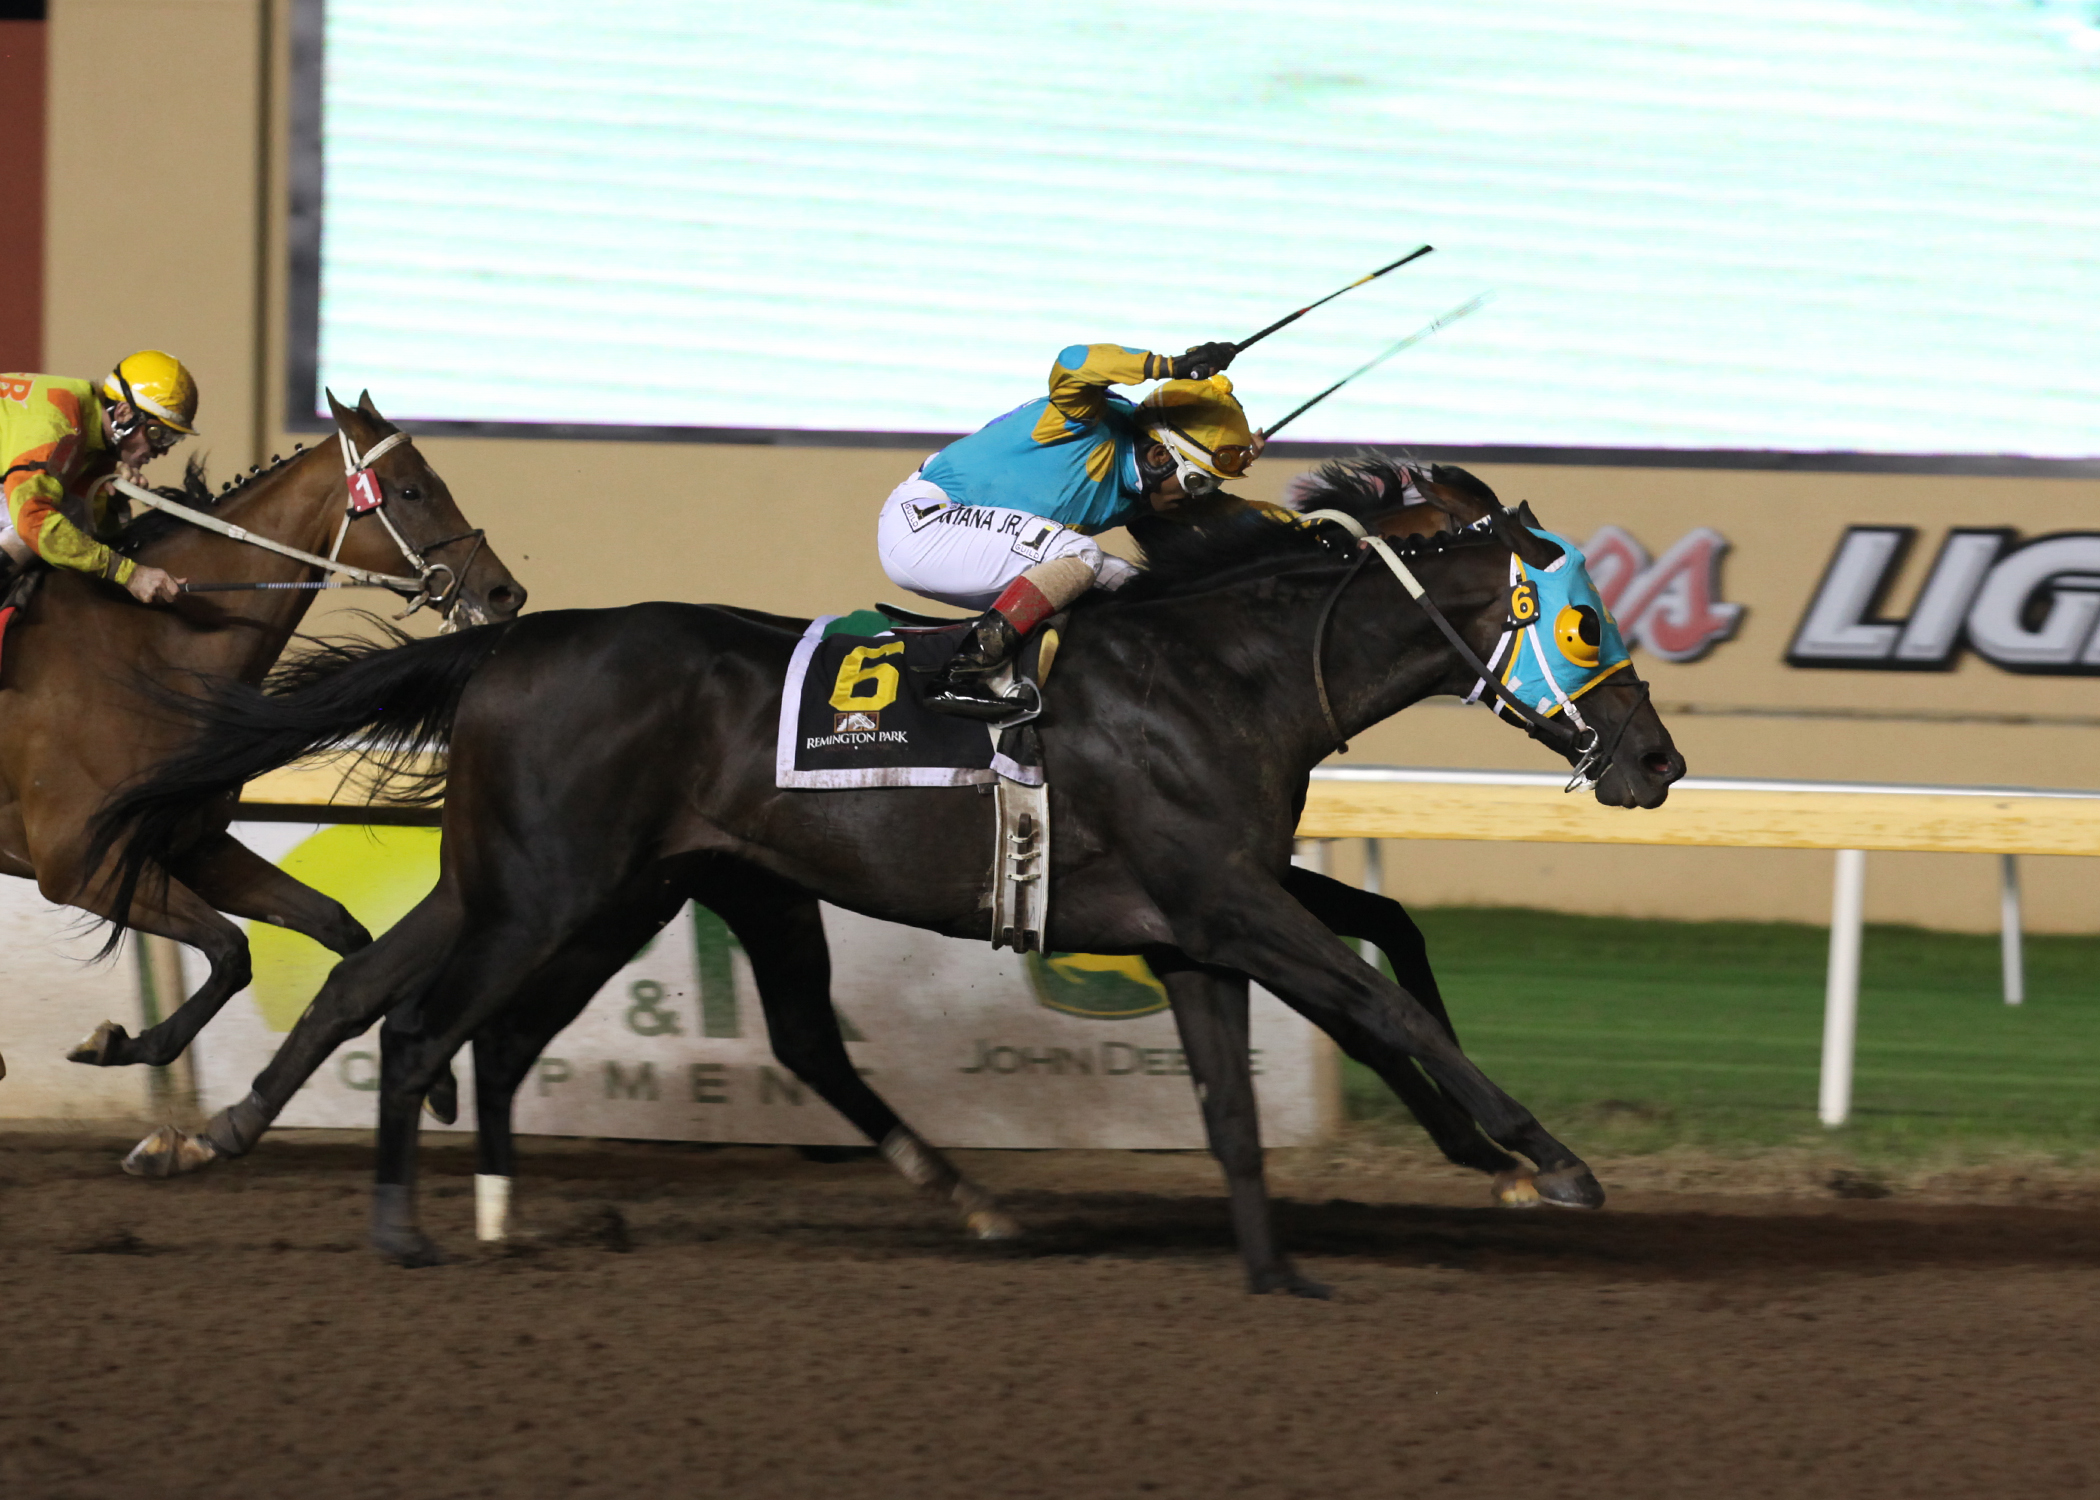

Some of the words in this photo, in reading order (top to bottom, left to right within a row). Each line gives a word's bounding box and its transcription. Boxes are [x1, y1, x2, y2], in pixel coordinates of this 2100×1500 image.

[355, 473, 376, 504] 1
[904, 503, 919, 528] GUILD
[997, 513, 1020, 537] JR.
[1014, 543, 1040, 560] GUILD
[1511, 586, 1535, 619] 6
[1785, 525, 2100, 675] LIG
[828, 641, 905, 711] 6
[806, 732, 876, 750] REMINGTON
[878, 730, 909, 743] PARK
